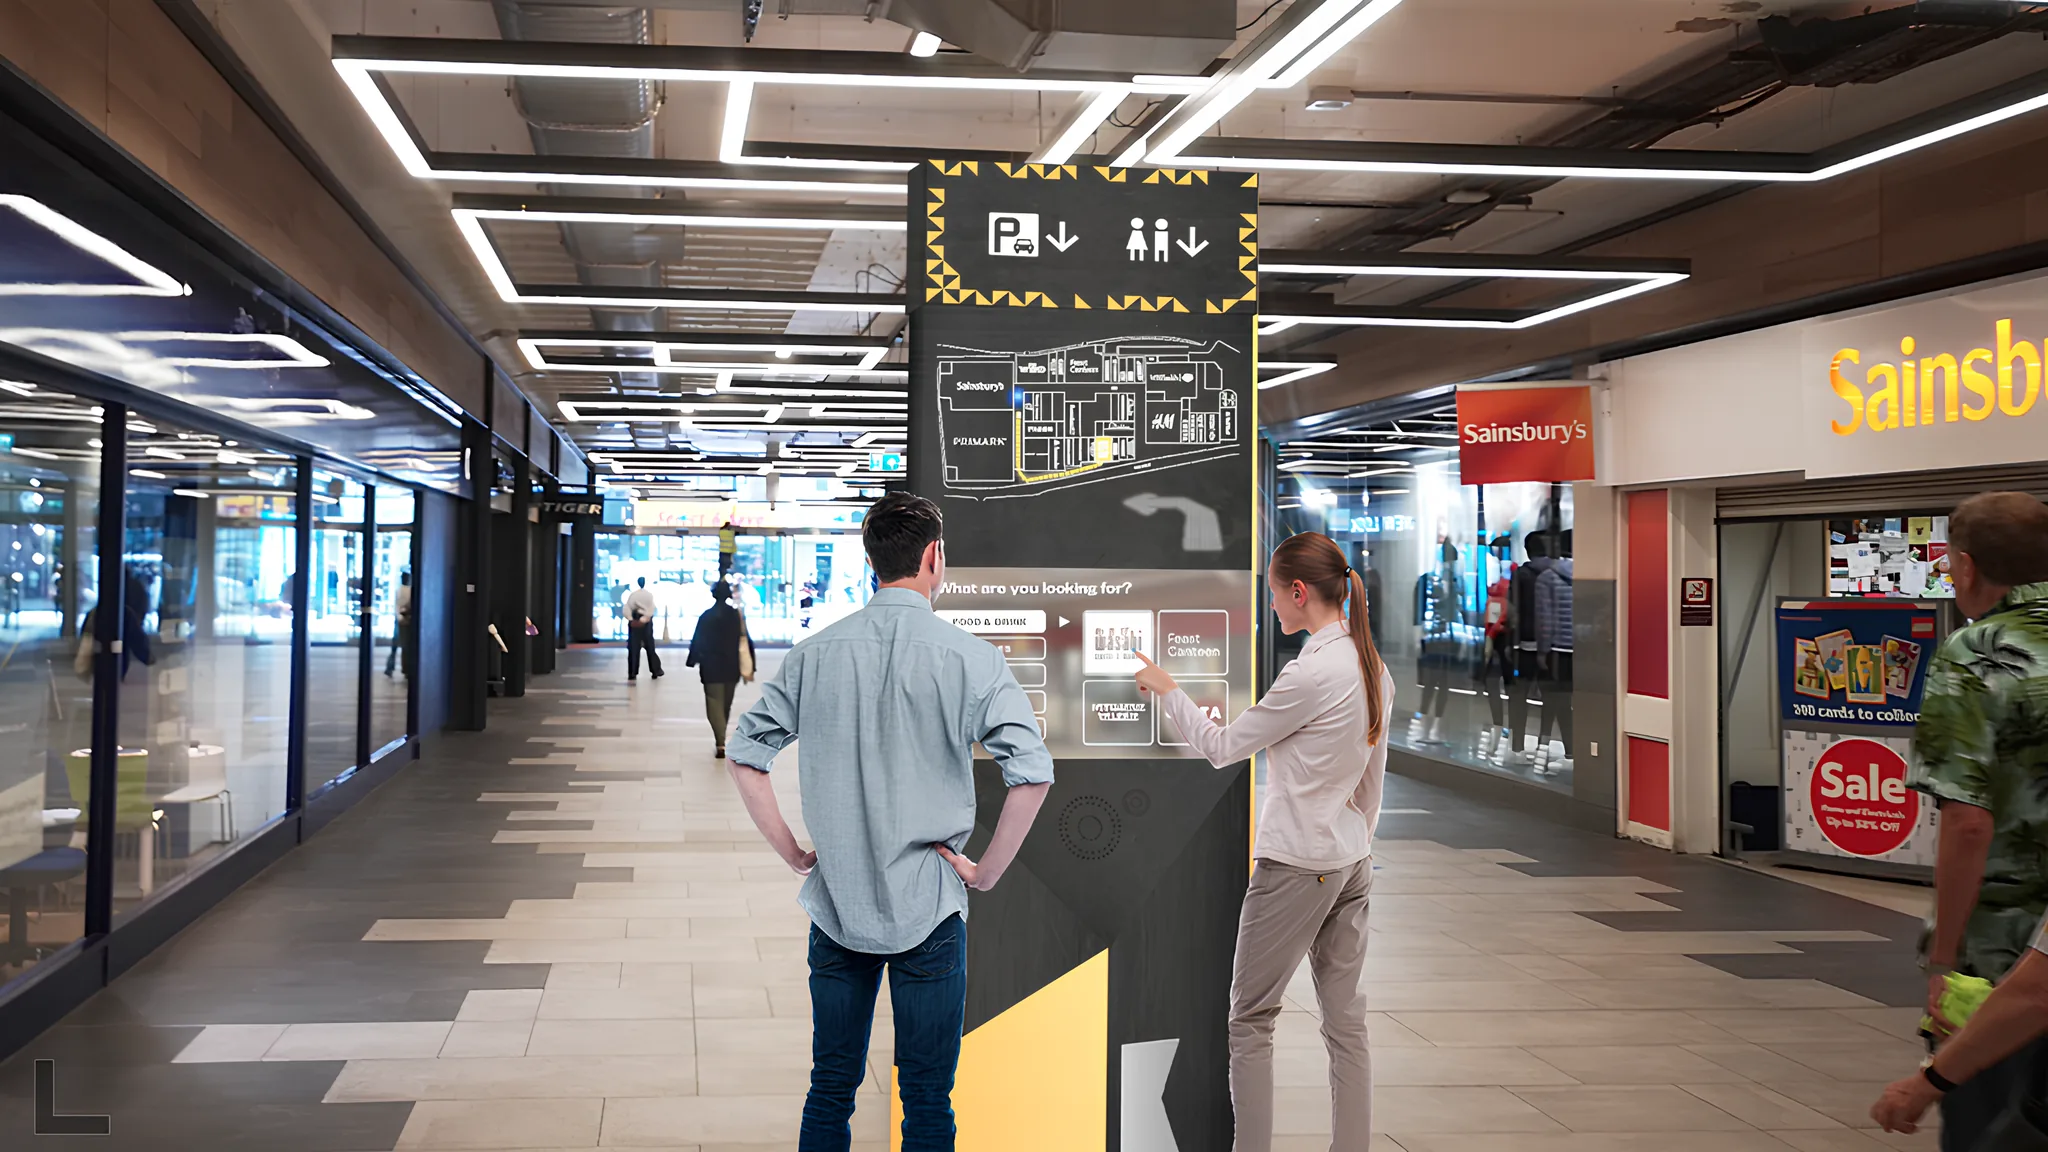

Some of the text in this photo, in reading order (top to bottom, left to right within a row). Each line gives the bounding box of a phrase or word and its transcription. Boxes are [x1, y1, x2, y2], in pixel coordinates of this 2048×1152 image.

[1829, 318, 2048, 436] Sainsb
[1463, 420, 1587, 444] Sainsbury's
[543, 502, 602, 514] TIGER
[940, 581, 1133, 596] What are you looking for?
[1818, 706, 1856, 719] cards
[1858, 707, 1874, 720] to
[1820, 761, 1906, 804] Sale
